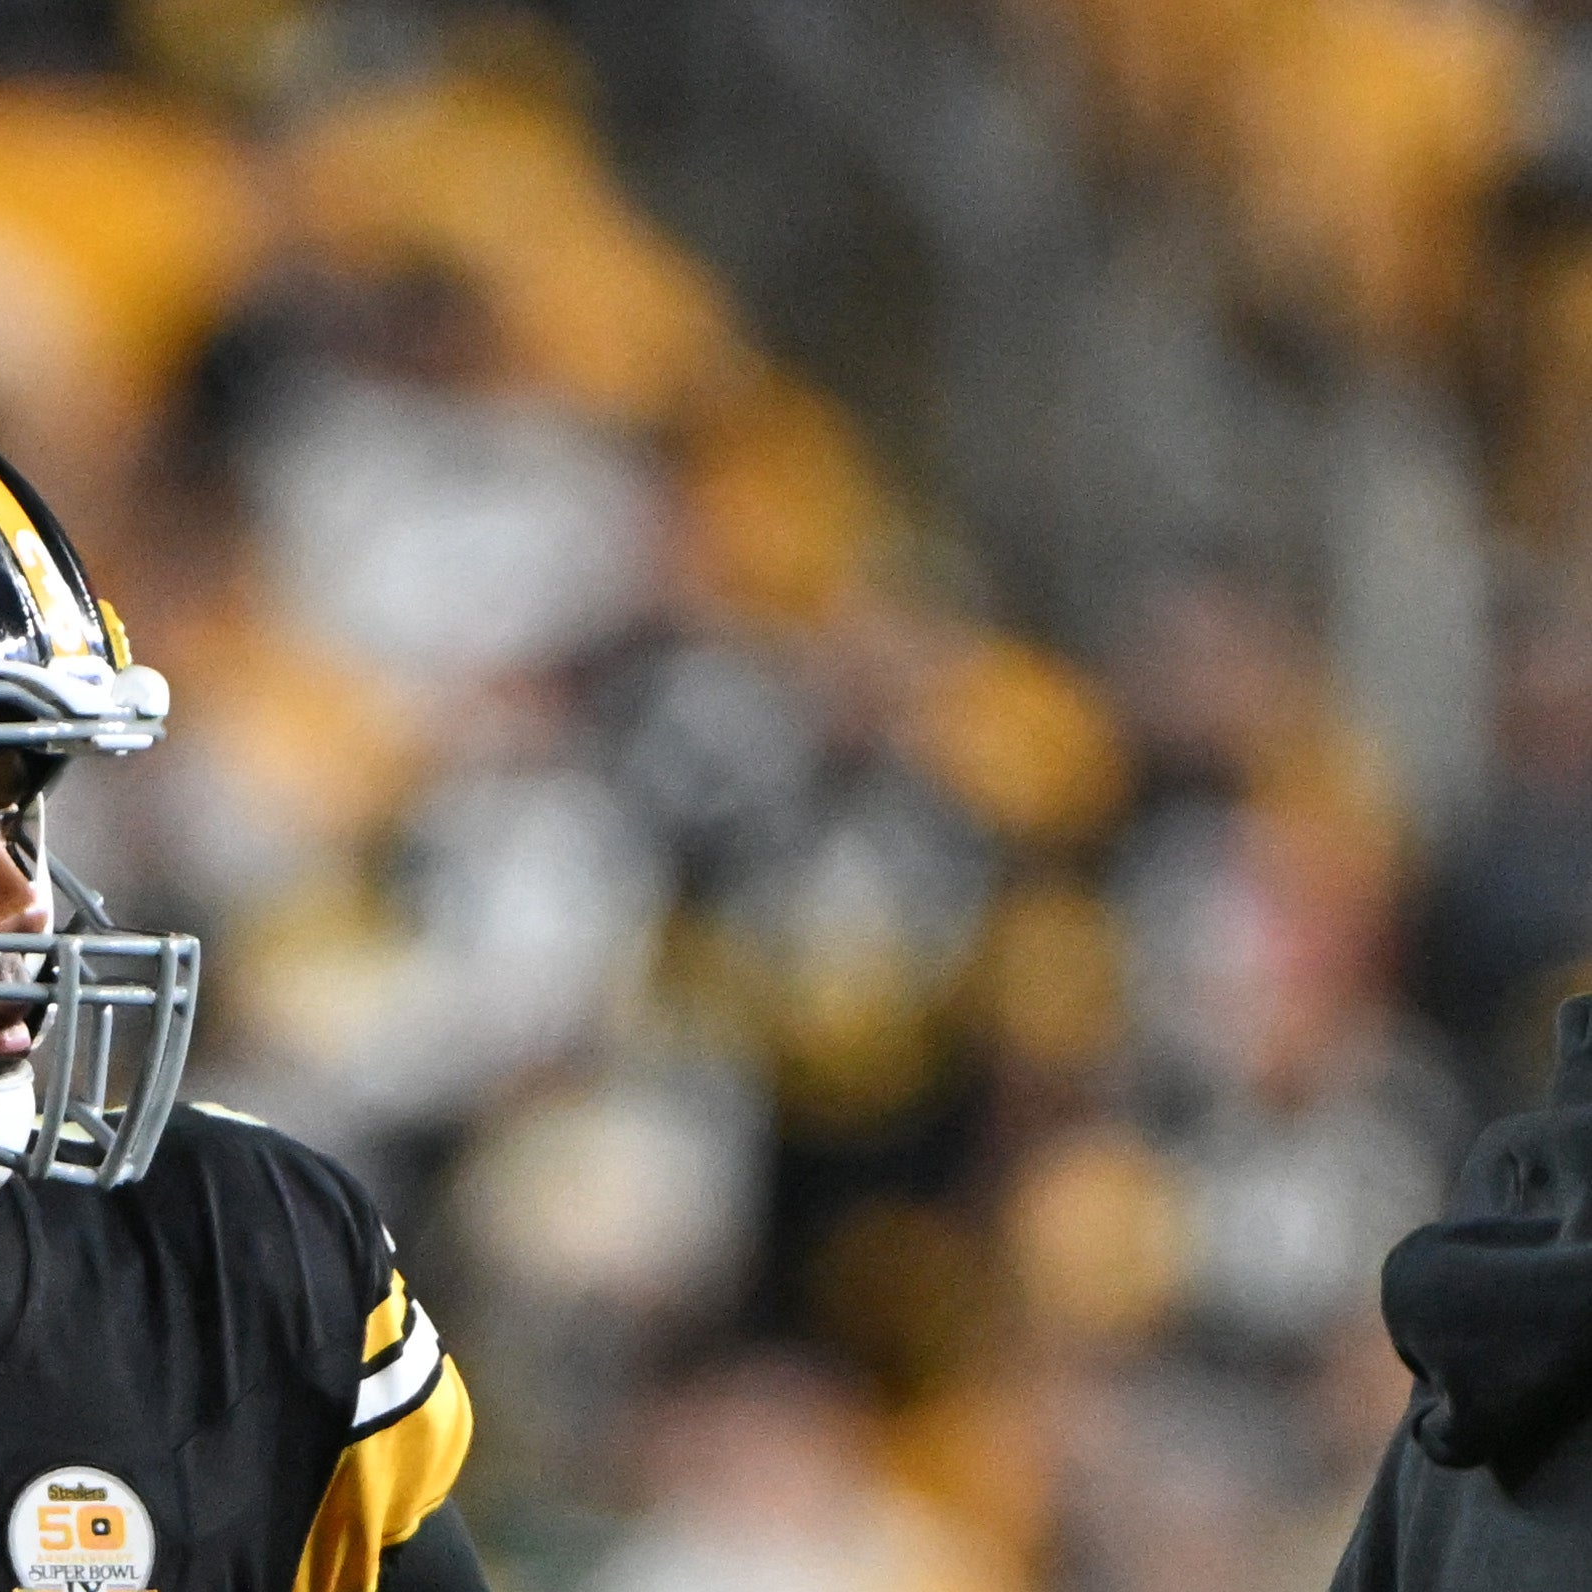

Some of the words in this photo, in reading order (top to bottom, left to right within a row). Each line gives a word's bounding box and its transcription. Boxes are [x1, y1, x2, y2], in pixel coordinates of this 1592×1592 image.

[36, 1505, 126, 1550] 50
[29, 1565, 86, 1581] SUPER
[89, 1564, 140, 1580] BOWL
